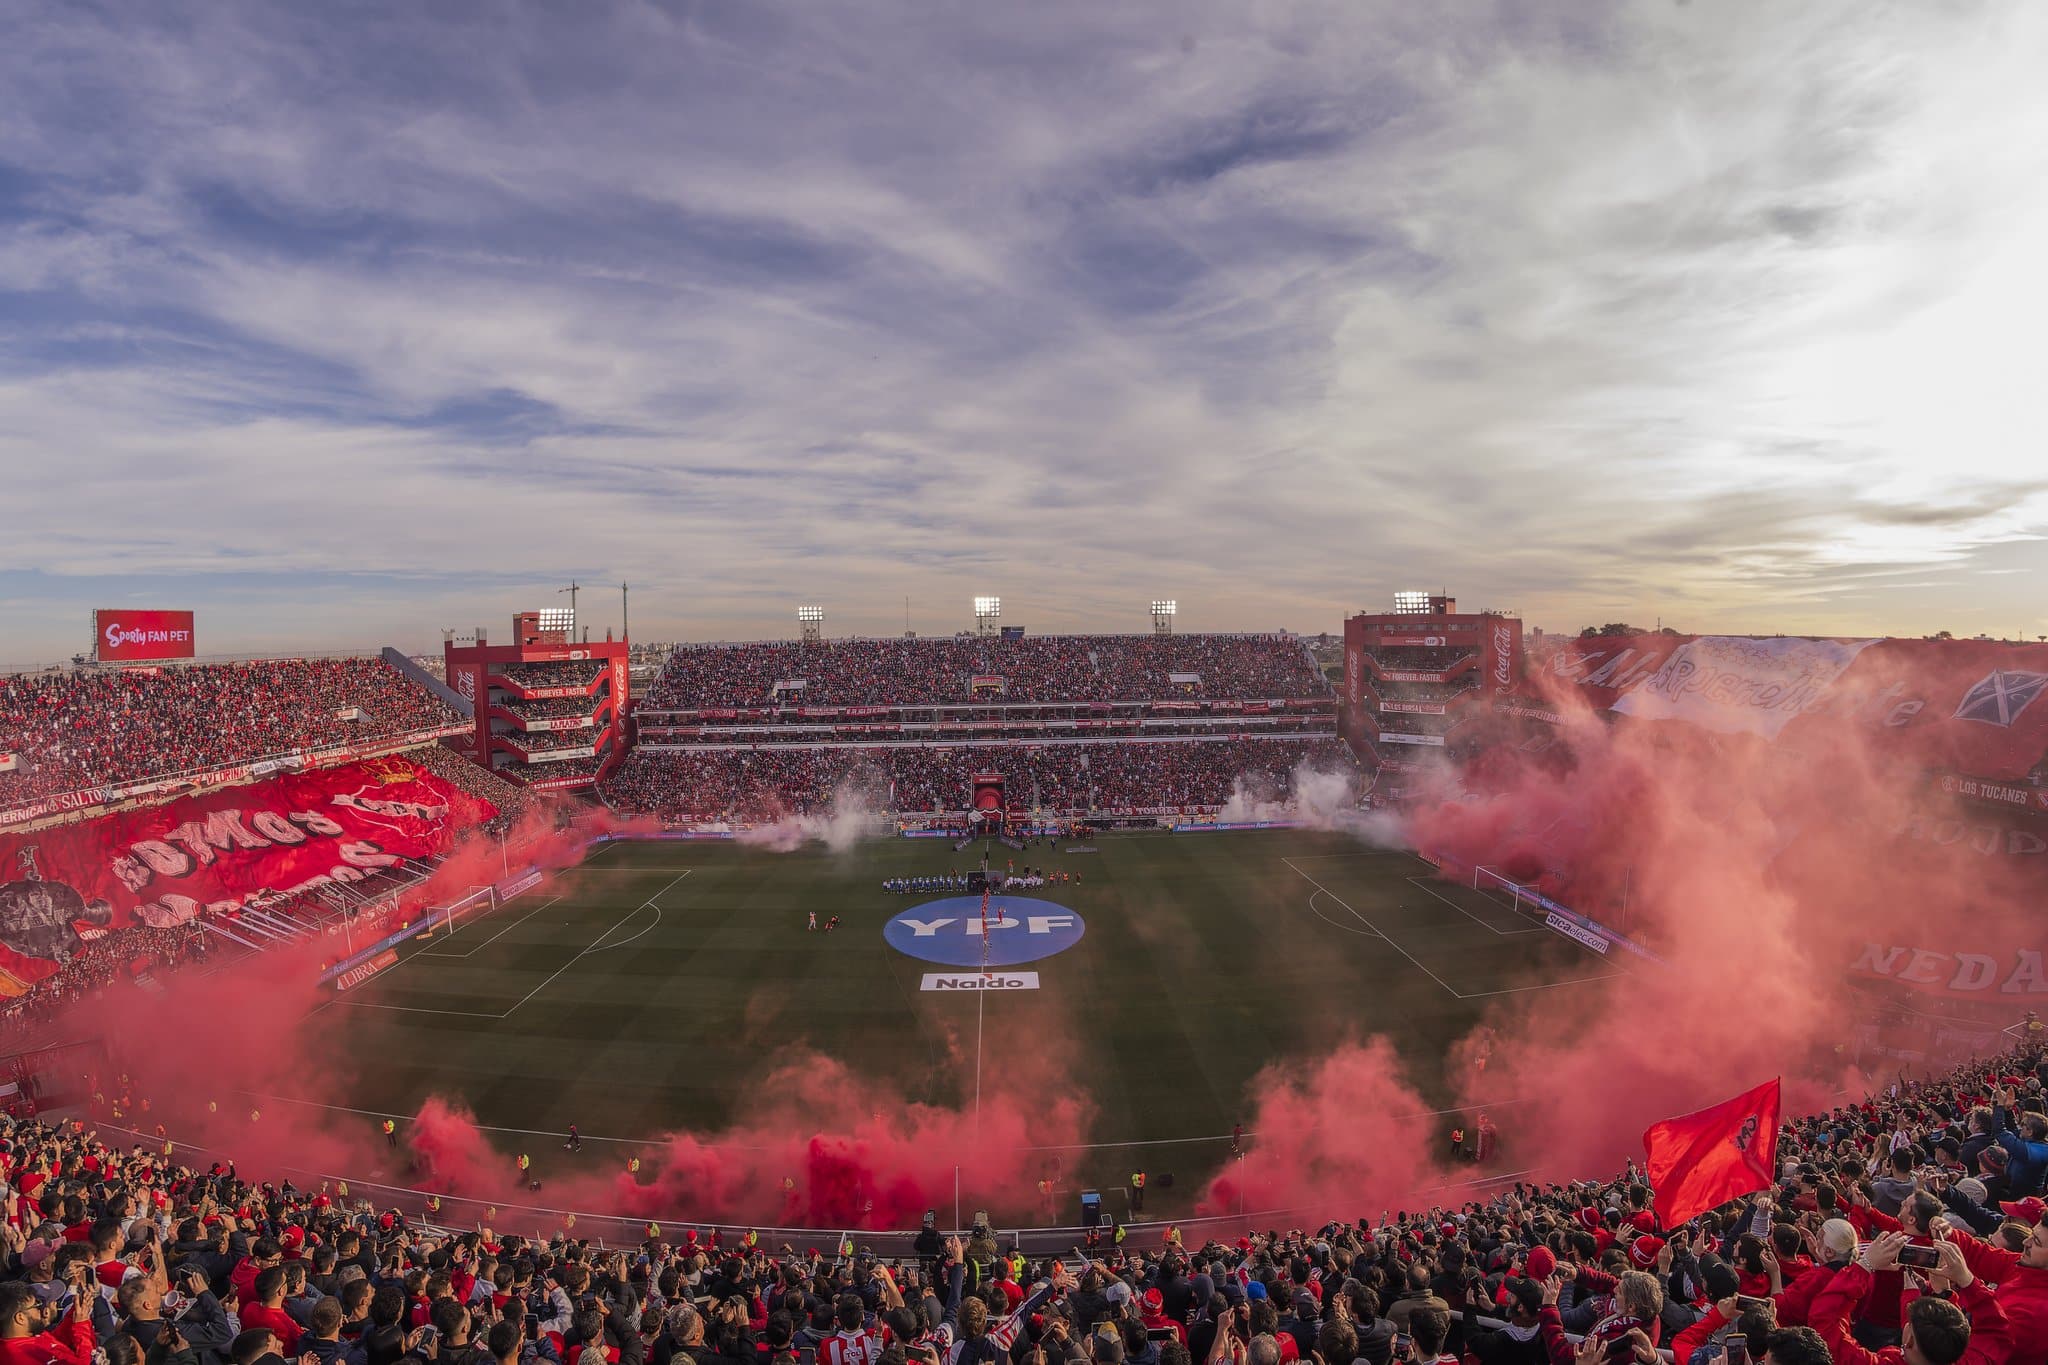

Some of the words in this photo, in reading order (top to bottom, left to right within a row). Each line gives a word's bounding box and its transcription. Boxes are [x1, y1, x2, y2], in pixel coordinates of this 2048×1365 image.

[148, 631, 167, 642] FAN
[170, 630, 189, 641] PET
[61, 789, 102, 811] SALTO
[1958, 781, 1977, 795] LOS
[1980, 784, 2028, 804] TUCANES
[1111, 807, 1133, 815] LAS
[1136, 806, 1180, 815] TORRES
[1184, 805, 1199, 814] DE
[897, 916, 1074, 936] YPF
[936, 977, 1024, 989] Naldo
